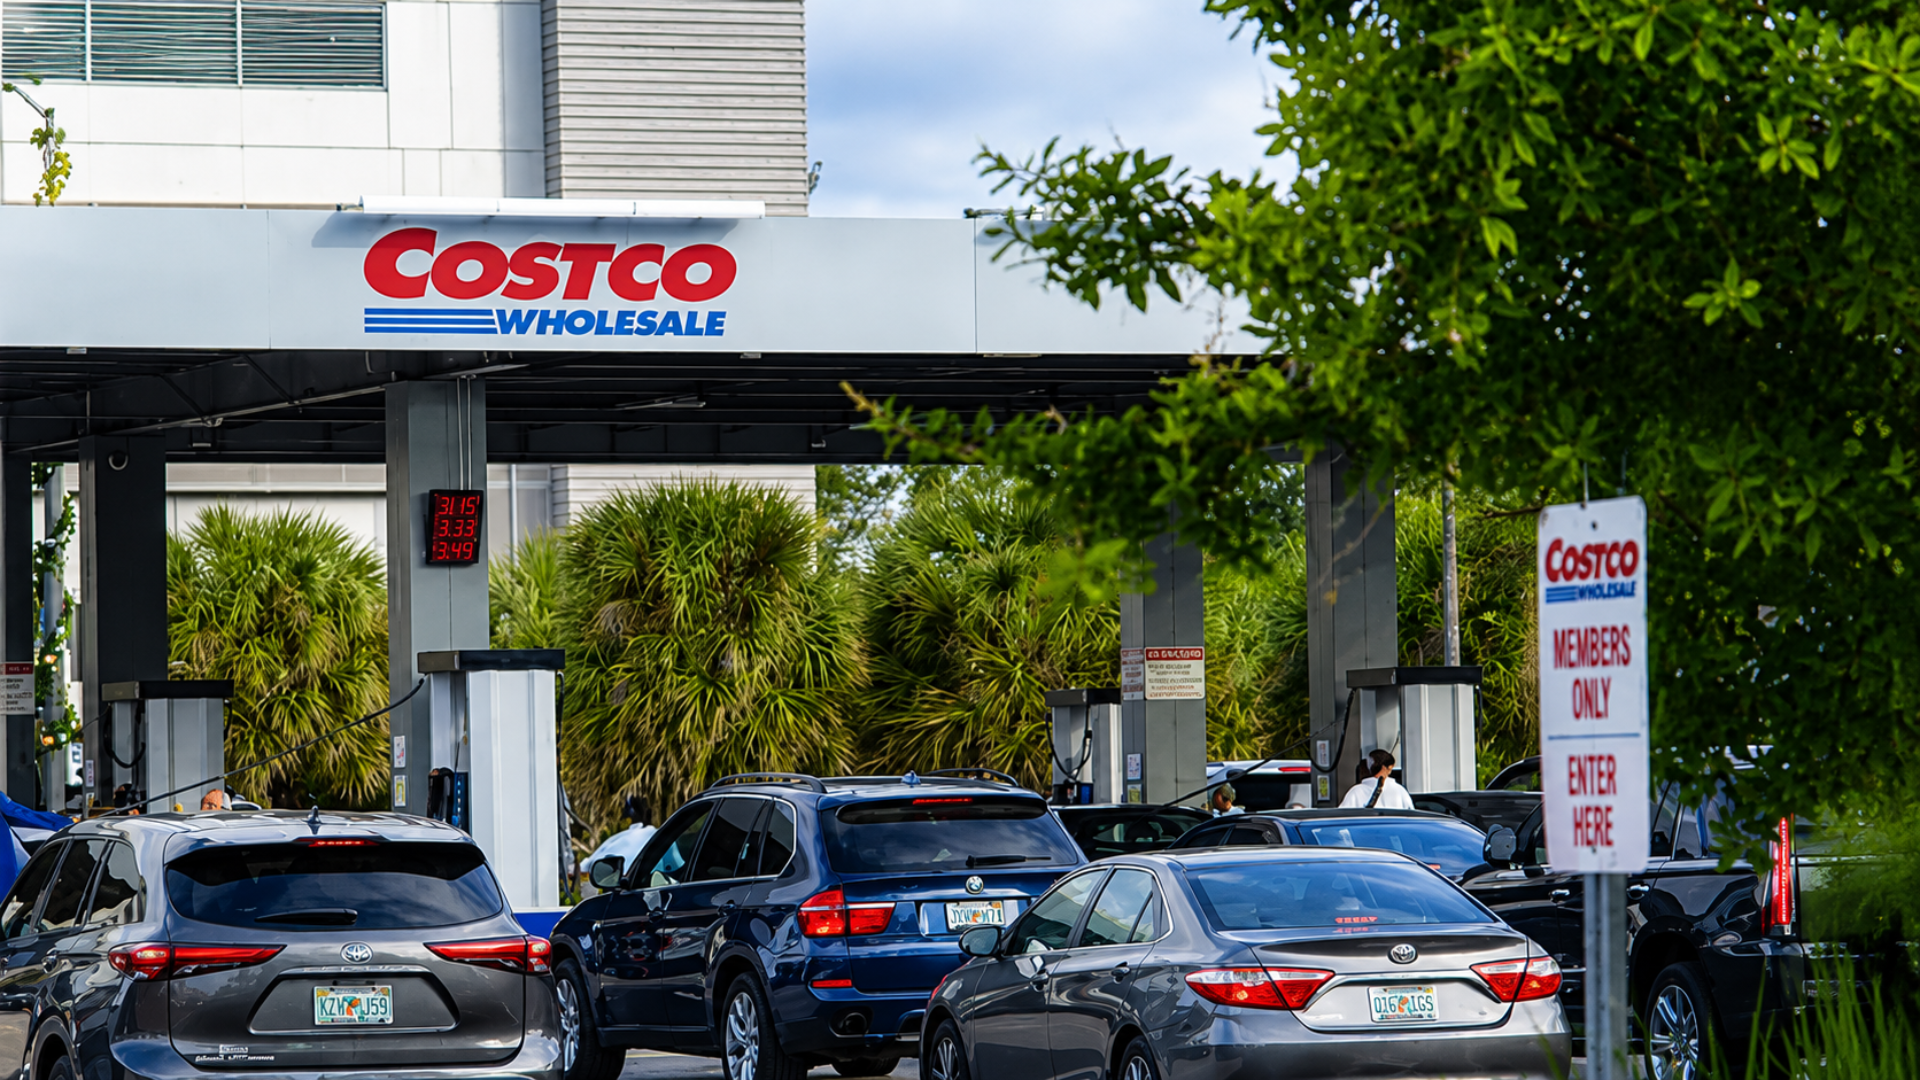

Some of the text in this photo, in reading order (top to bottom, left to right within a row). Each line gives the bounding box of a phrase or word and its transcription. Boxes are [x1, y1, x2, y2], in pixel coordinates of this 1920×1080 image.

[363, 227, 737, 302] COSTCO
[494, 309, 727, 337] WHOLESALE
[438, 519, 475, 537] 3.33
[437, 542, 474, 560] 3.49
[1545, 537, 1639, 582] COSTCO
[1578, 580, 1636, 600] WHOLESALE
[1553, 624, 1631, 669] MEMBERS
[1572, 676, 1612, 721] ONLY
[1568, 754, 1617, 796] ENTER
[1573, 805, 1614, 847] HERE
